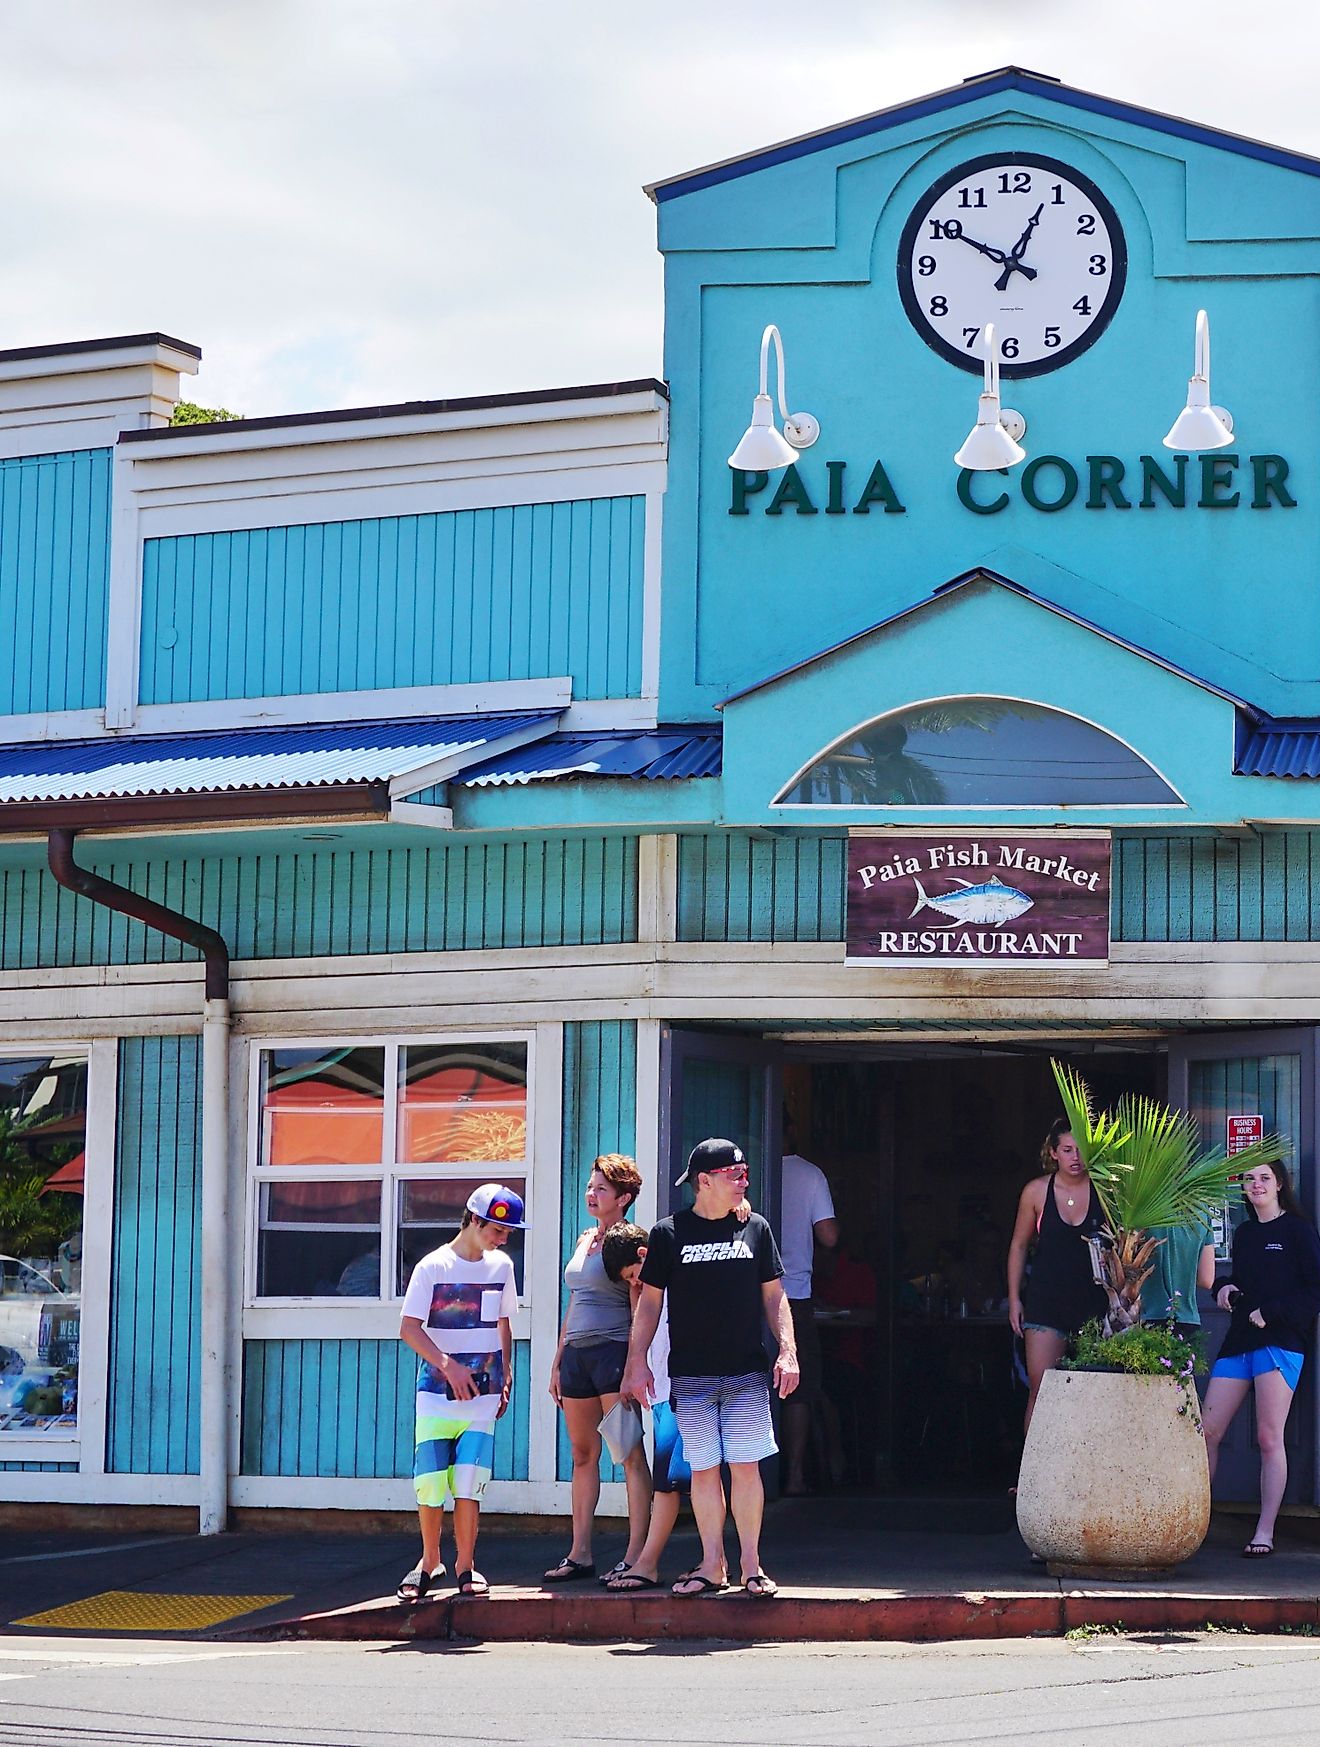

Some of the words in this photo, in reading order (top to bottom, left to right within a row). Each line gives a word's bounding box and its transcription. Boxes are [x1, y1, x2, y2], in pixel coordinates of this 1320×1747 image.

[998, 172, 1032, 194] 12
[957, 187, 988, 208] 11
[1051, 184, 1065, 205] 1
[929, 219, 963, 240] 10
[1076, 214, 1096, 236] 2
[918, 255, 937, 277] 9
[1088, 254, 1107, 276] 3
[929, 295, 949, 317] 8
[1072, 294, 1092, 316] 4
[962, 327, 981, 348] 7
[1001, 337, 1020, 359] 6
[1044, 326, 1062, 348] 5
[727, 459, 906, 516] PAIA
[956, 454, 1298, 515] CORNER
[857, 854, 922, 890] Paia
[926, 843, 990, 870] Fish
[996, 845, 1101, 892] Market
[878, 931, 1084, 955] RESTAURANT
[1233, 1118, 1257, 1127] BUSINESS
[1236, 1127, 1254, 1135] HOURS
[680, 1240, 743, 1255] PROFILE
[681, 1249, 741, 1264] DESIGN
